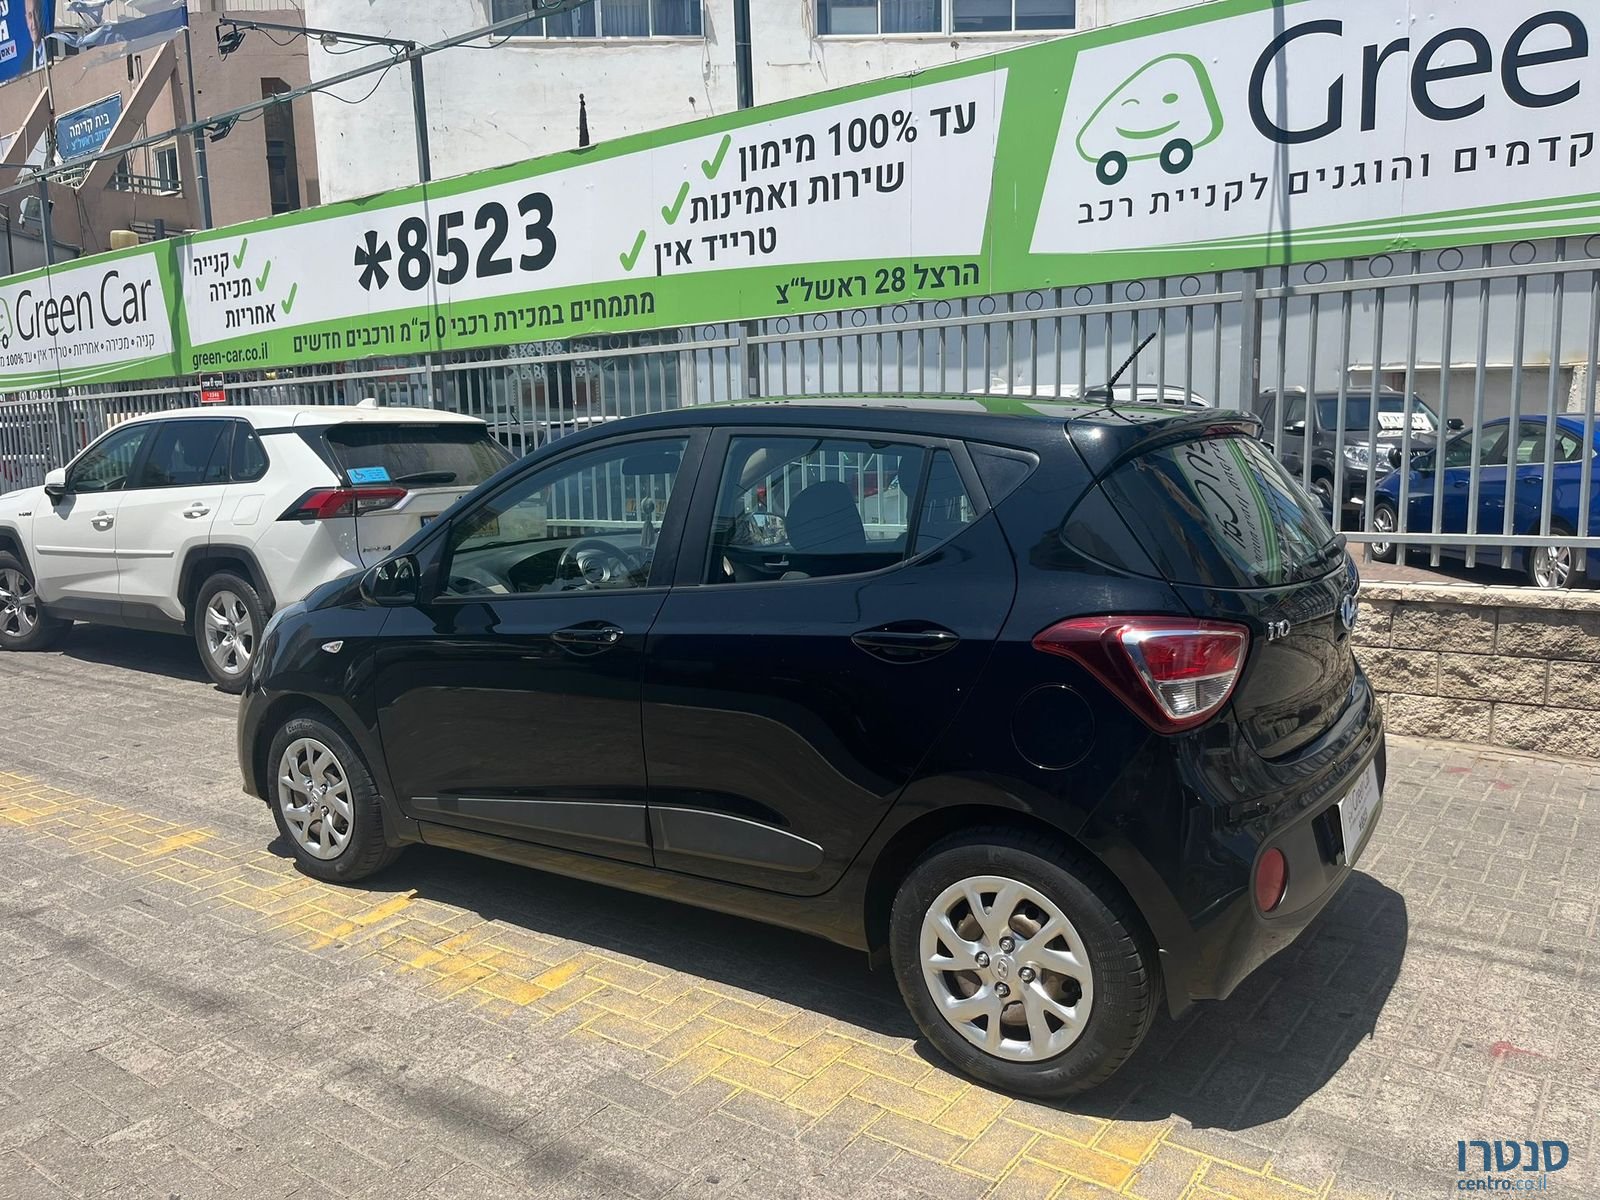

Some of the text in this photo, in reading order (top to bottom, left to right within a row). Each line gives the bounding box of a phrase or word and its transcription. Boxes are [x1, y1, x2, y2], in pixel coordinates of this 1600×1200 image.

[1247, 9, 1590, 145] Gree
[69, 113, 110, 138] בית קדימה
[738, 101, 976, 182] עד 100% מימון
[1077, 132, 1596, 225] קדמים והוגנים לקניית רכב
[690, 161, 905, 225] שירות ואמינות
[654, 226, 778, 277] טרייד אין
[193, 252, 230, 277] קנייה
[209, 278, 252, 302] מכירה
[775, 262, 980, 305] הרצל 28 ראשל"צ
[16, 270, 152, 341] Green Car
[225, 304, 276, 328] אחריות
[293, 291, 655, 353] מתמחים במכירת רכבי 0 ק"מ ורכבים חדשים
[73, 340, 100, 355] אחריות
[106, 337, 130, 350] מכירה
[136, 333, 155, 348] קניה
[6, 352, 24, 366] 100%
[24, 351, 33, 363] עד
[192, 342, 268, 371] green-car.co.il
[1268, 619, 1291, 641] i10
